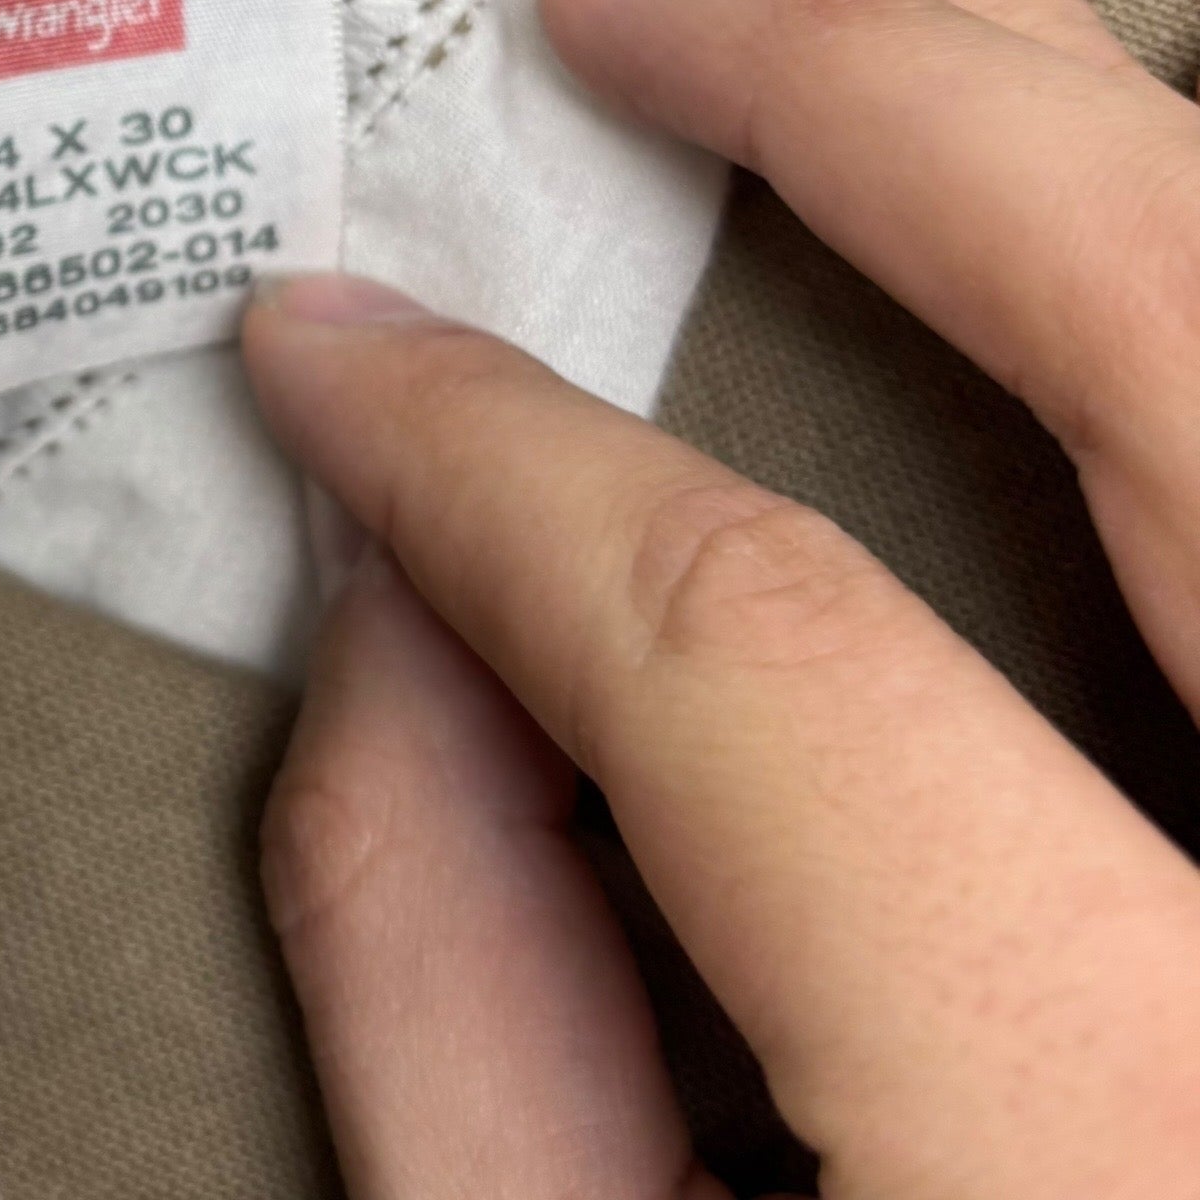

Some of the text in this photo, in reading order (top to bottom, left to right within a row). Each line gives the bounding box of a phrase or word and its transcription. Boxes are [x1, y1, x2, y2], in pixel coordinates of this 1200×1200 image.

[49, 118, 90, 161] X
[120, 105, 194, 147] 30
[105, 187, 243, 236] 2030
